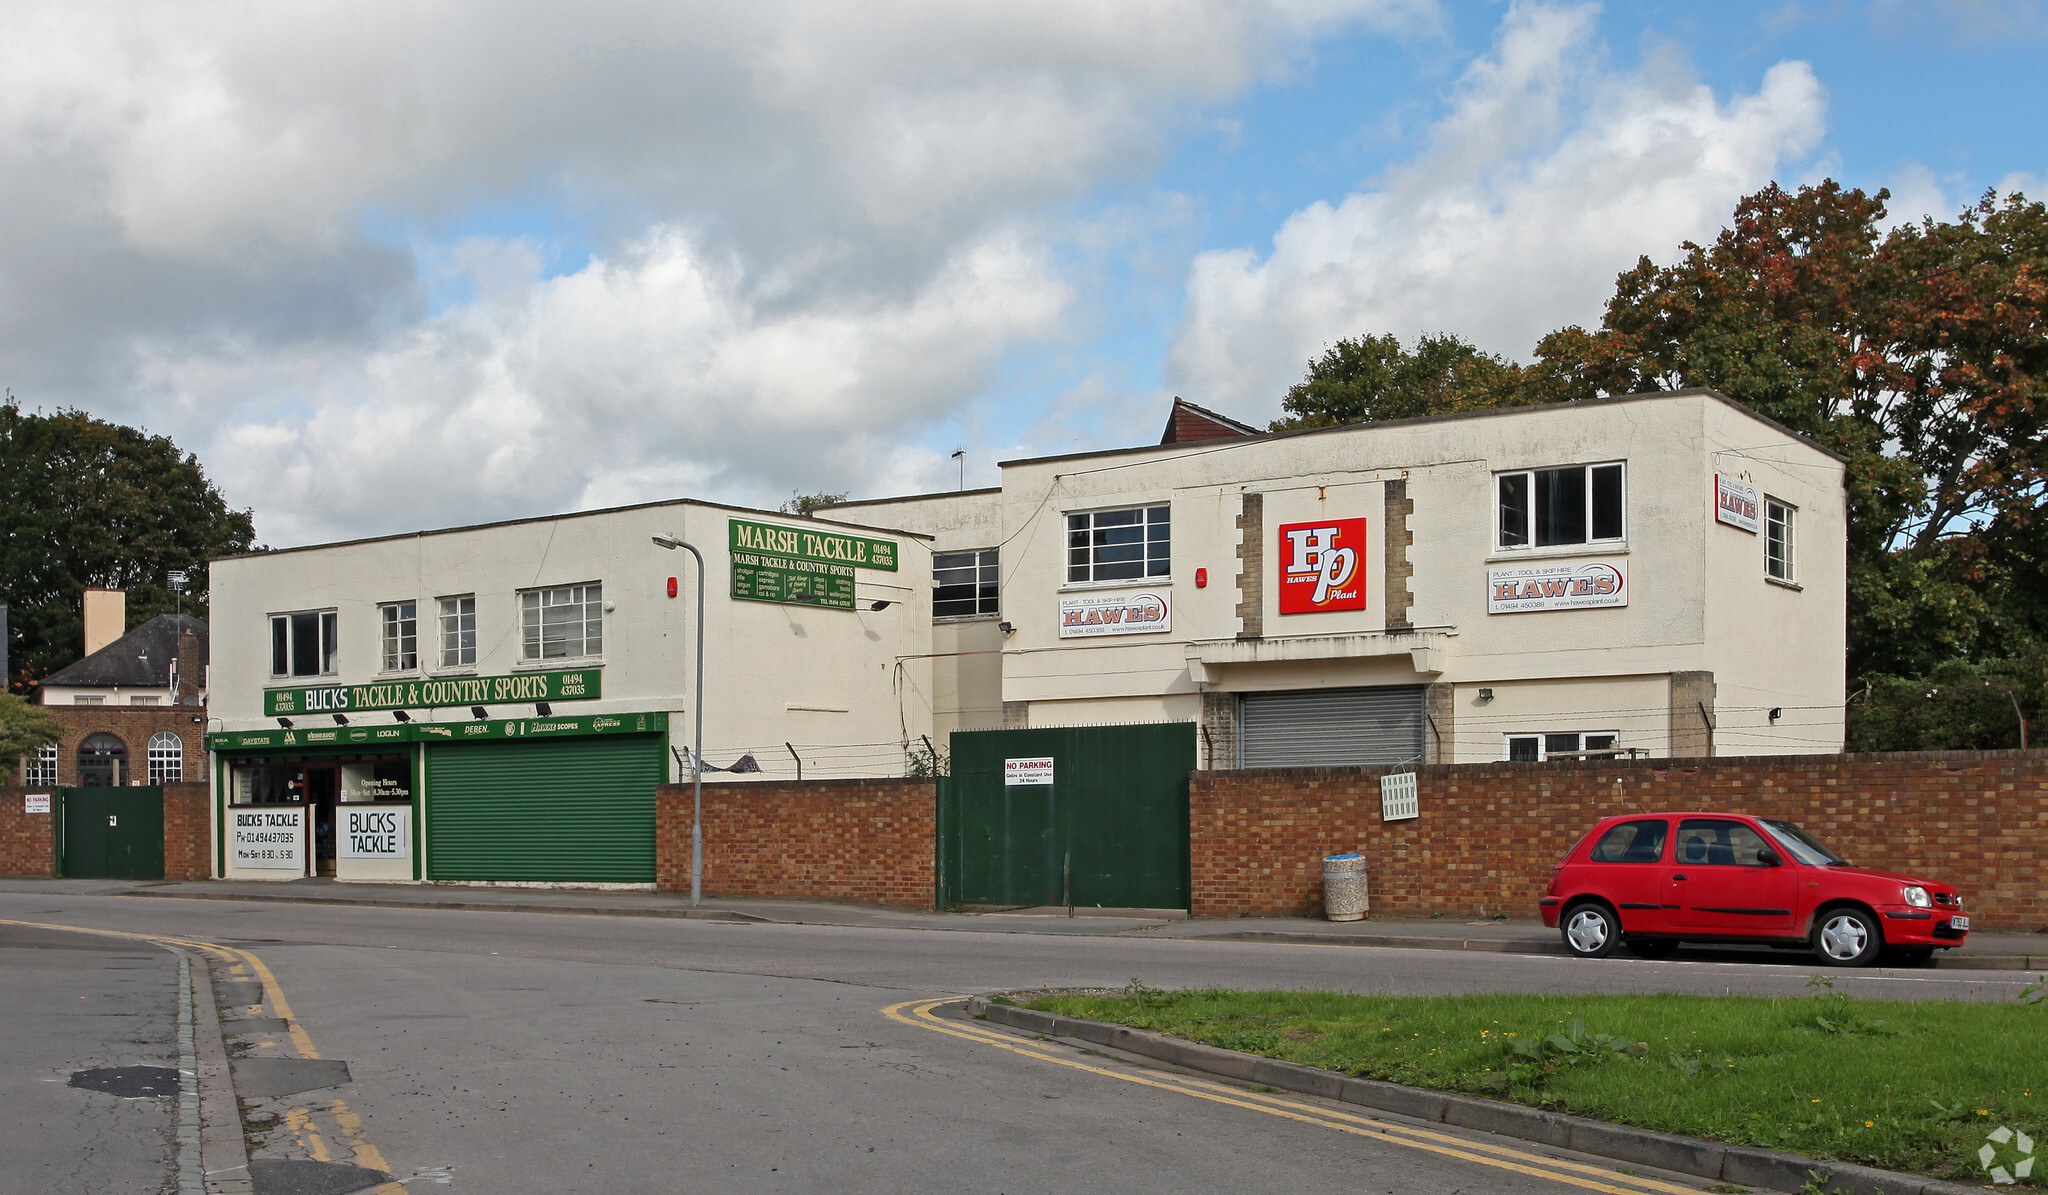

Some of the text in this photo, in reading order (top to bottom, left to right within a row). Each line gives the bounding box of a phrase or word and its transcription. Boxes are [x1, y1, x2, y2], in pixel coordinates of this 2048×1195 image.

[736, 524, 866, 562] MARSH TACKLE
[872, 543, 891, 554] 01494
[734, 553, 854, 577] MARSH TACKLE & COUNTRY SPORTS
[871, 556, 893, 566] 437035
[1286, 576, 1318, 584] HAWES
[1494, 575, 1615, 601] HAWES
[1330, 589, 1357, 600] Plant
[1063, 604, 1160, 626] HAWES
[562, 674, 583, 684] 01494
[305, 675, 548, 711] BUCKS TACKLE & COUNTRY SPORTS
[560, 684, 585, 696] 437035
[276, 692, 293, 701] 01494
[274, 702, 295, 712] 437035
[464, 725, 488, 734] DEBEN
[1006, 760, 1052, 770] NO PARKING
[361, 778, 397, 788] Opening Hours
[237, 814, 298, 826] BUCKS TACKLE
[350, 812, 396, 833] BUCKS
[350, 835, 396, 853] TACKLE
